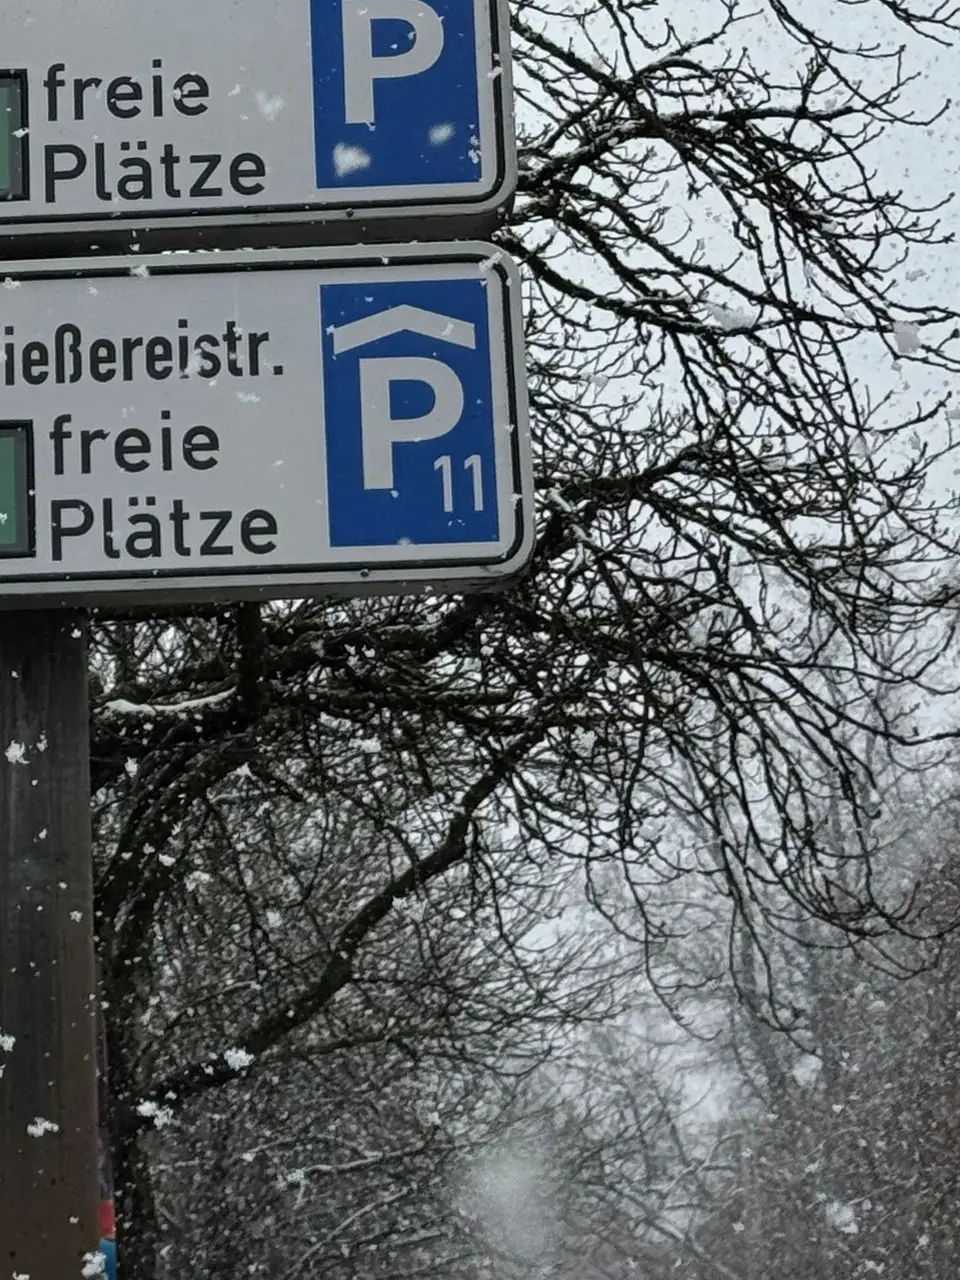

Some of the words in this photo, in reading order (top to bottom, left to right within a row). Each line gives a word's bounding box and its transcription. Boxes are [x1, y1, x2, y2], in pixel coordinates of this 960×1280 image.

[44, 59, 208, 121] freie
[45, 141, 265, 203] Plätze
[49, 411, 219, 475] freie
[359, 357, 464, 490] P
[433, 454, 483, 513] 11
[51, 497, 277, 561] Plätze
